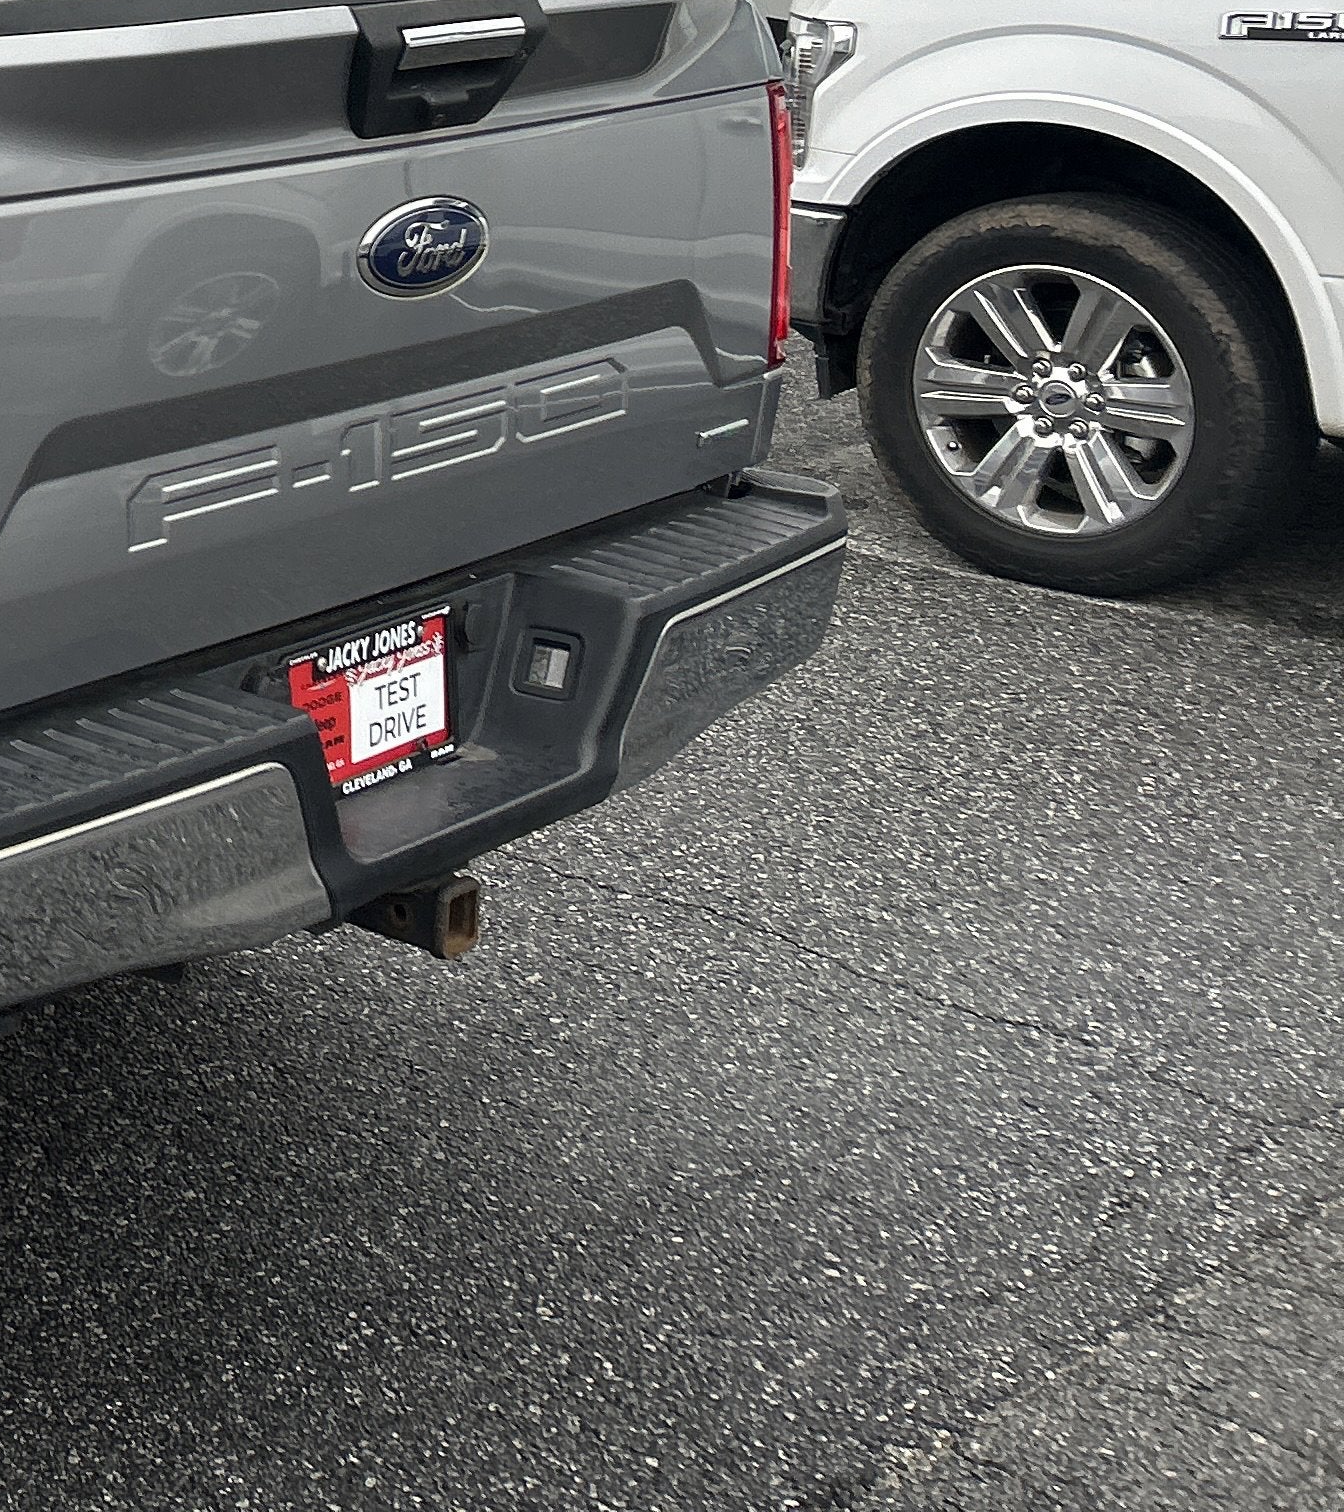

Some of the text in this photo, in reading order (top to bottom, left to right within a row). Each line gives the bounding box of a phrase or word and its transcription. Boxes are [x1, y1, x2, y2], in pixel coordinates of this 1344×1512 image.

[397, 219, 467, 278] Ford
[126, 356, 629, 552] F-150
[326, 620, 416, 674] JACKY JONES
[375, 672, 421, 710] TEST
[369, 704, 427, 748] DRIVE
